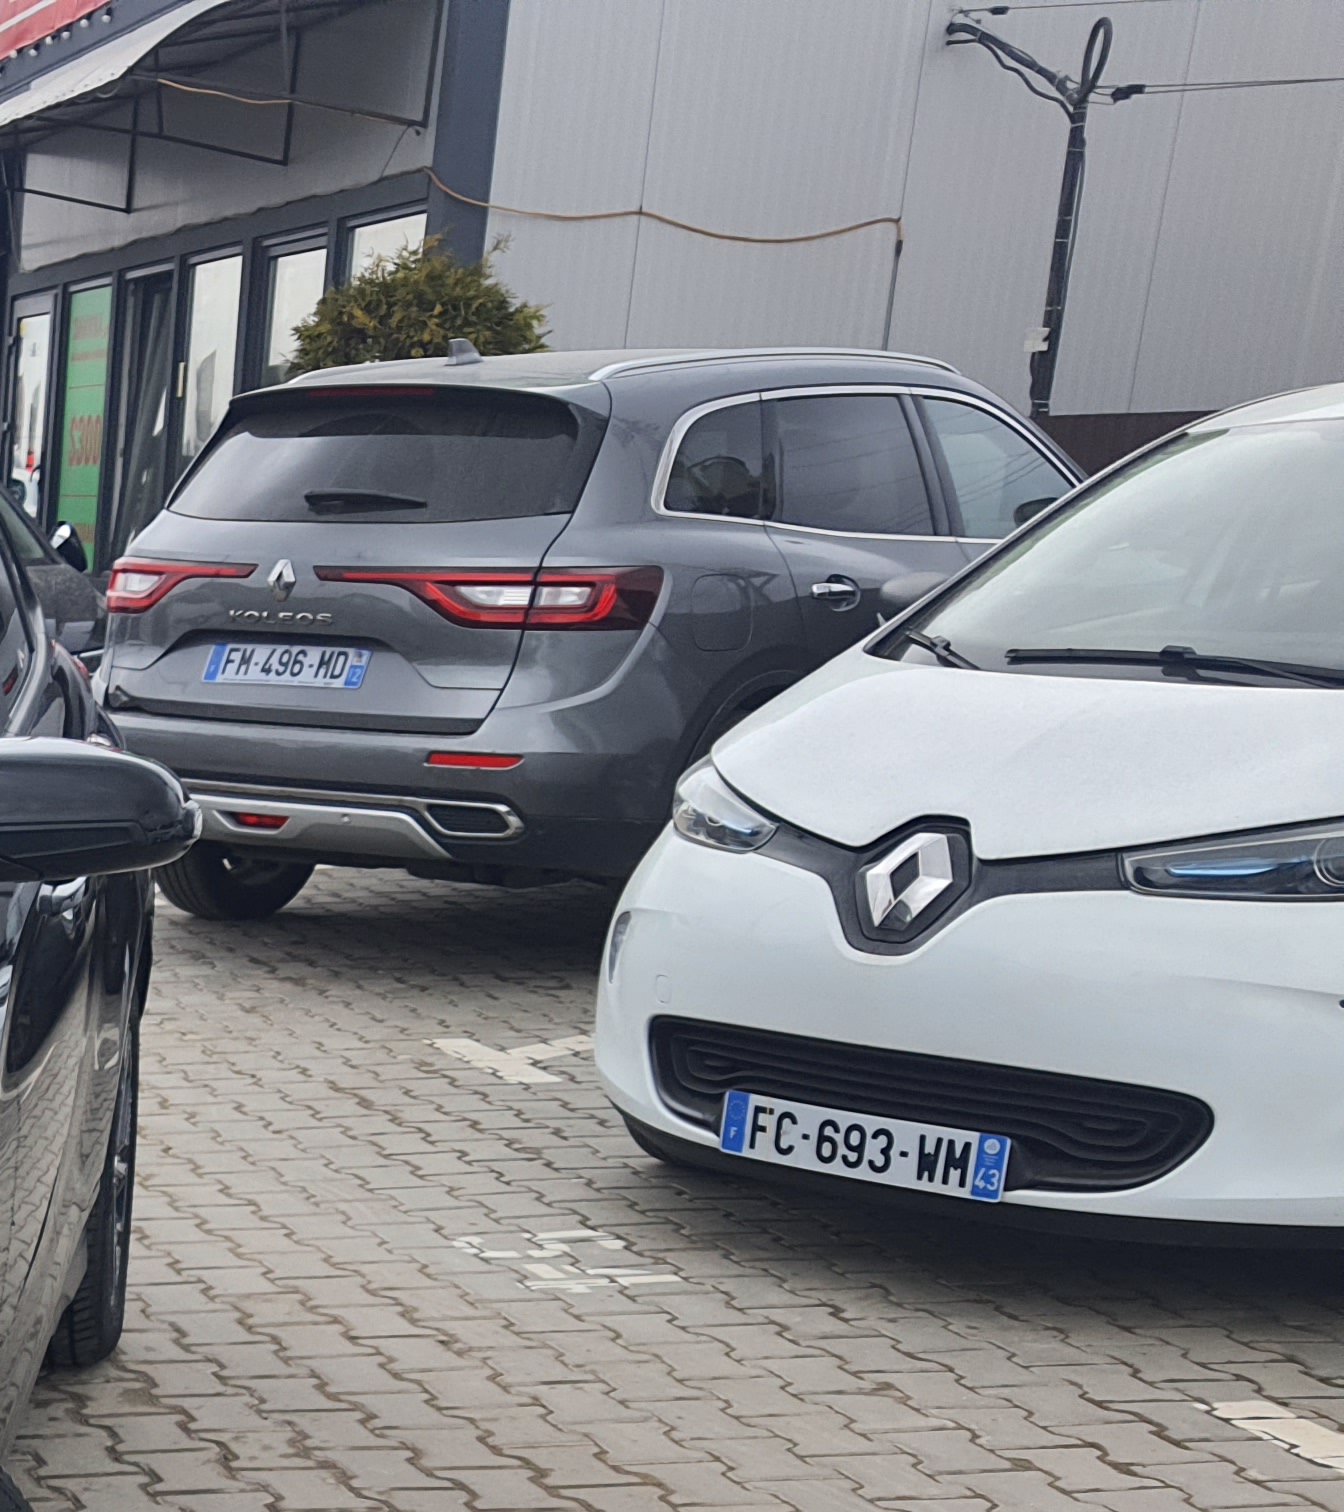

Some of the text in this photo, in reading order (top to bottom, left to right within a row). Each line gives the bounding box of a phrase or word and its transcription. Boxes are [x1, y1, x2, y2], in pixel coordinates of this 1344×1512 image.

[229, 609, 333, 626] KOLEOS
[221, 647, 349, 680] FM-496-MD
[728, 1126, 739, 1139] F
[749, 1105, 973, 1188] FC-693-WM
[974, 1168, 1000, 1191] 43
